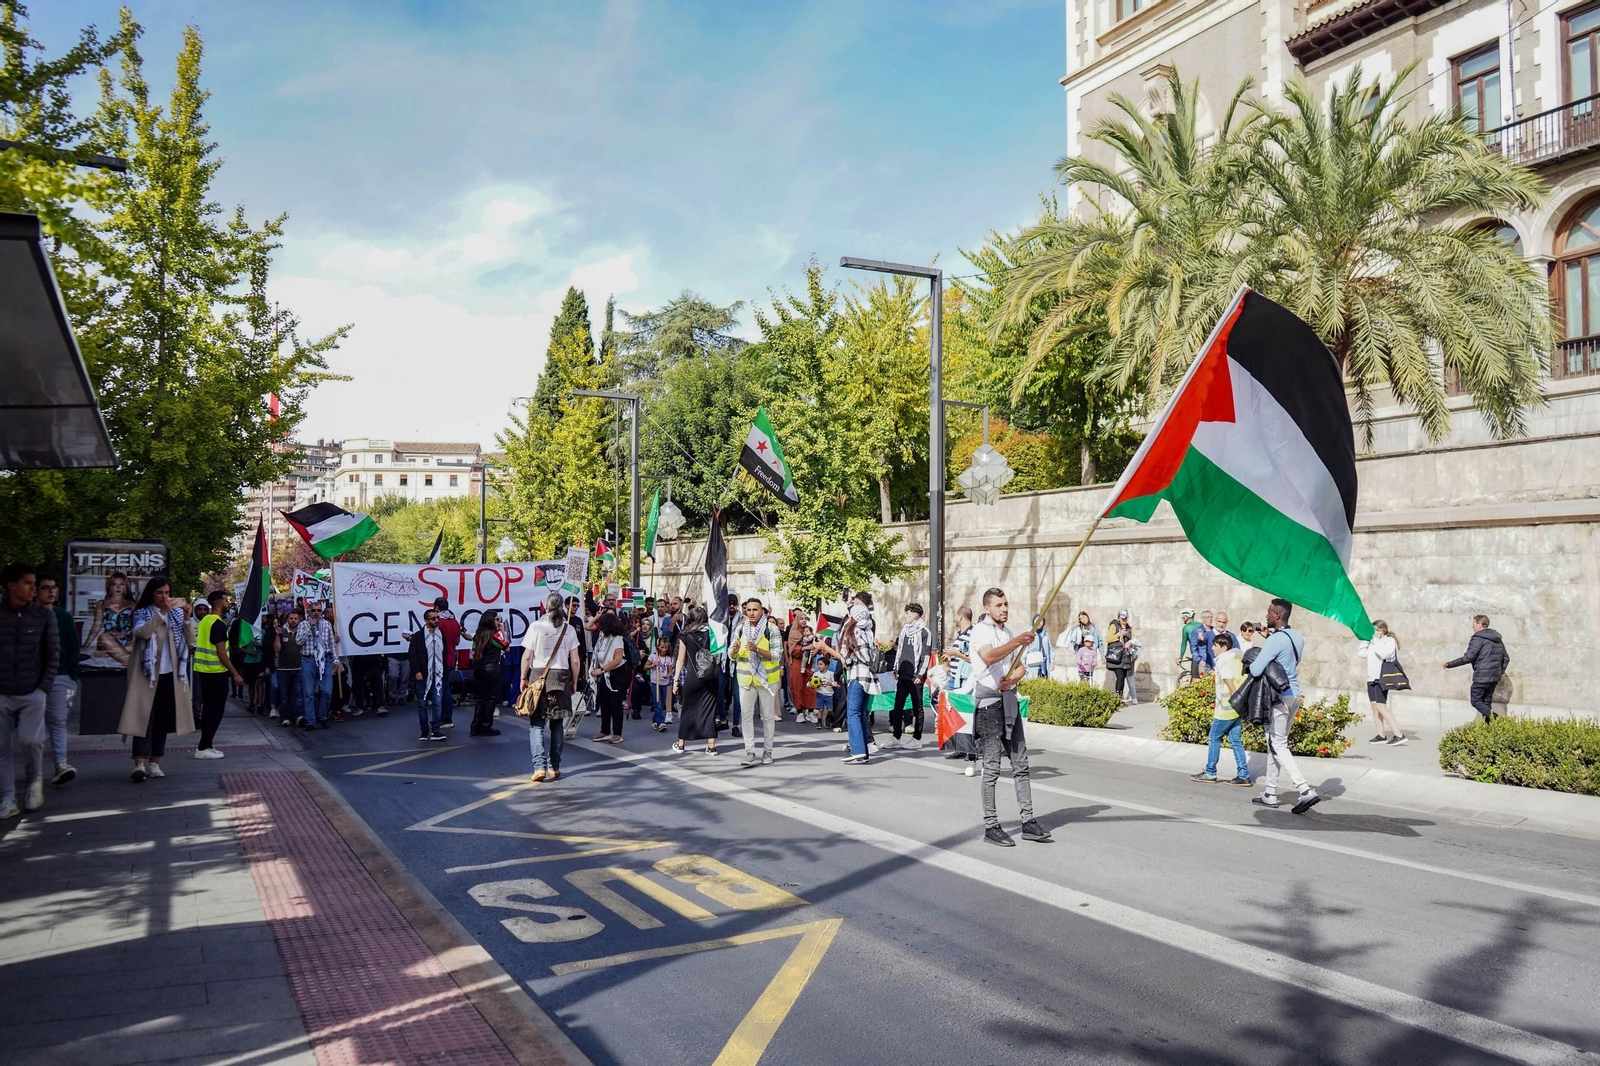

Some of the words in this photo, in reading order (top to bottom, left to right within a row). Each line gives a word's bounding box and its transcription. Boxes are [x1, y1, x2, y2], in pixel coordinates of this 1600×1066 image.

[754, 465, 780, 492] Freedom
[357, 580, 406, 593] GAZA
[418, 567, 524, 607] STOP
[467, 855, 811, 943] BUS
